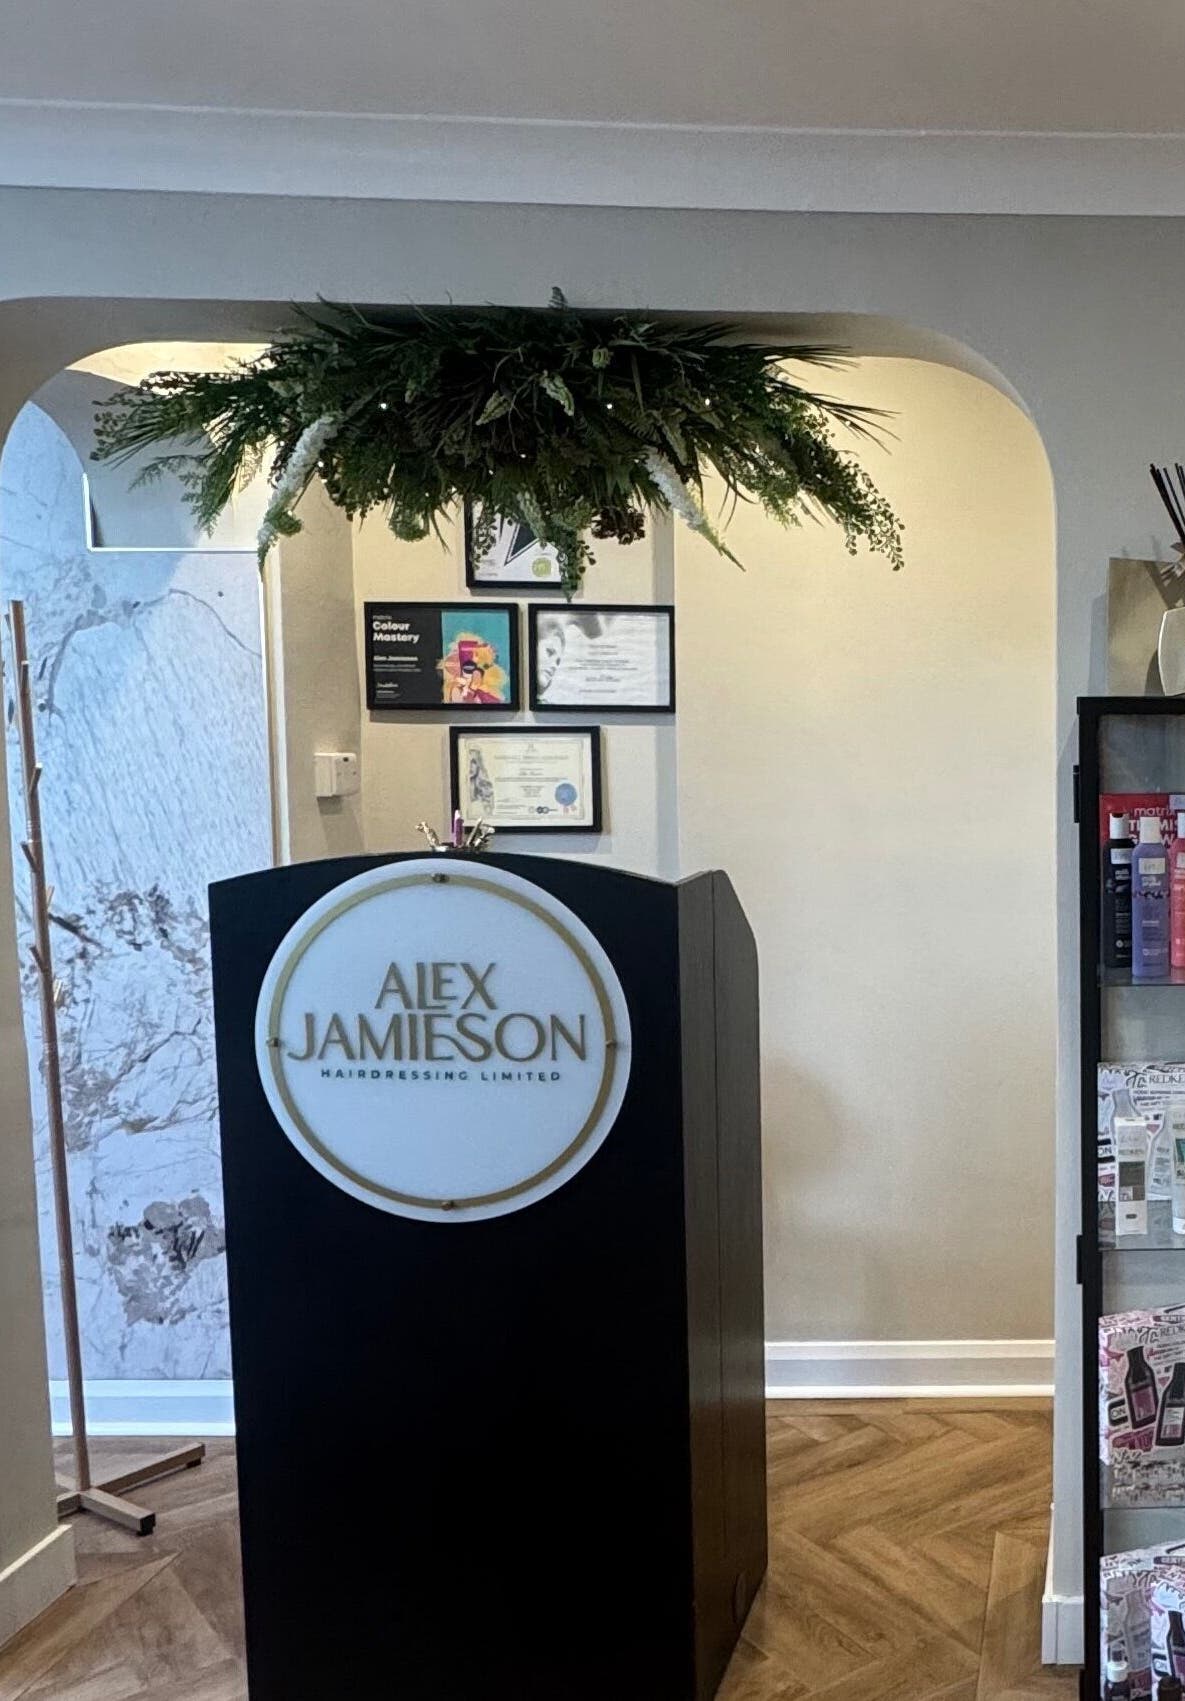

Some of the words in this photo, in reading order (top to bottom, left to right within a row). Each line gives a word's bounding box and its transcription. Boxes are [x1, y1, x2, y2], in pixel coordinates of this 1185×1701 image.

[372, 621, 410, 631] Colour
[373, 632, 420, 644] Mastery
[374, 962, 498, 1010] ALEX
[287, 1012, 588, 1062] JAMIESON
[320, 1069, 469, 1081] HAIRDRESSING
[480, 1071, 561, 1082] LIMITED
